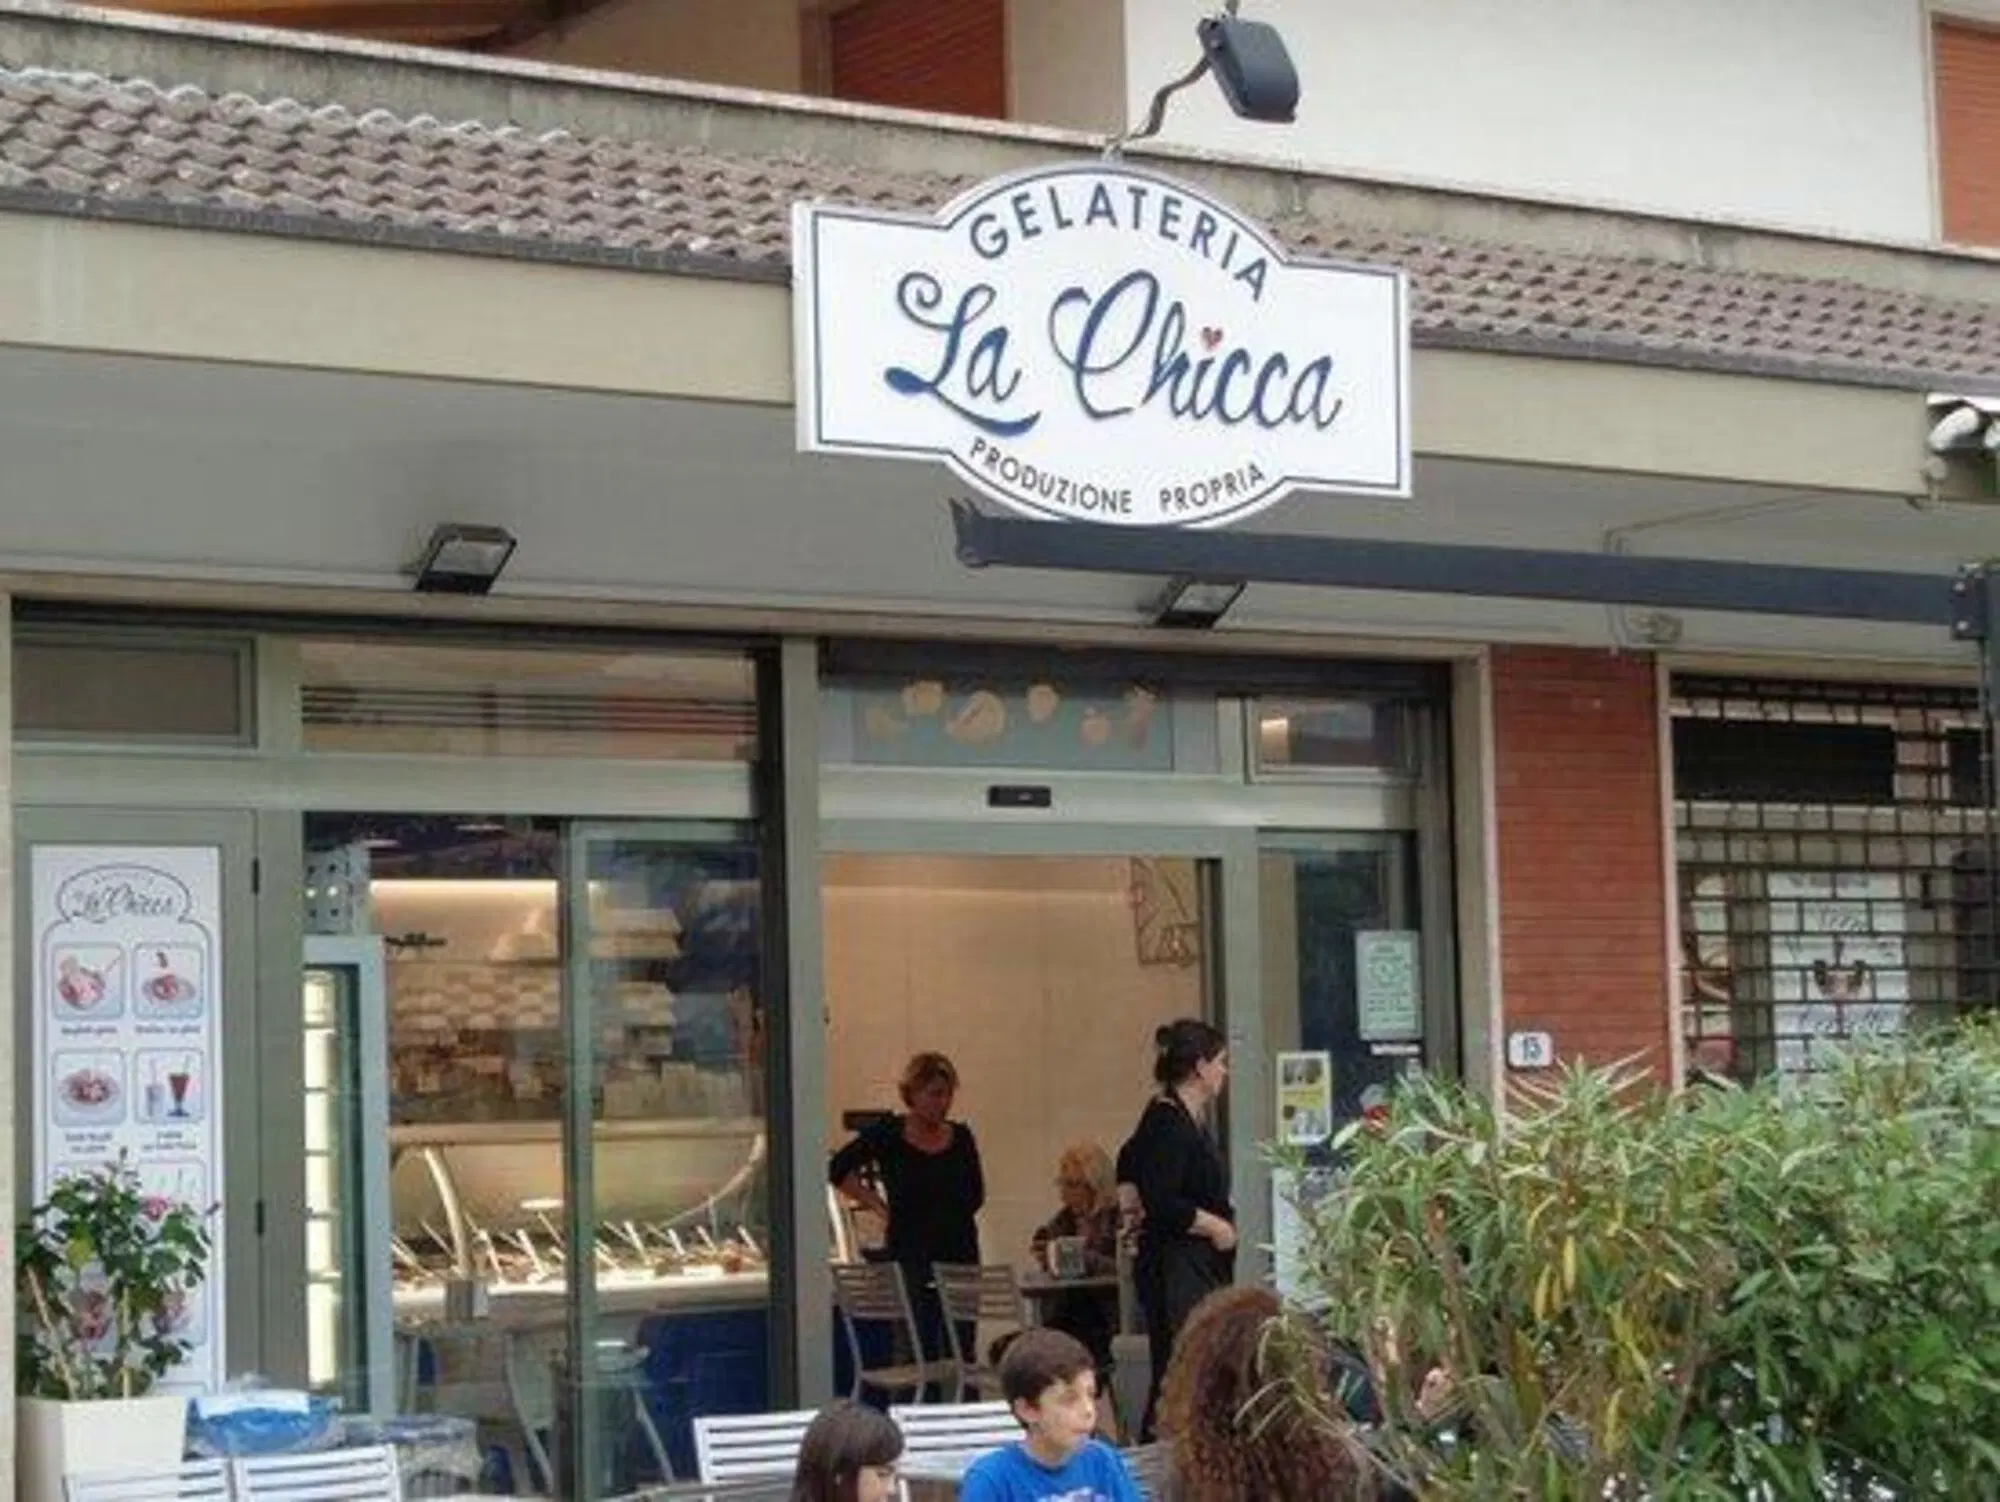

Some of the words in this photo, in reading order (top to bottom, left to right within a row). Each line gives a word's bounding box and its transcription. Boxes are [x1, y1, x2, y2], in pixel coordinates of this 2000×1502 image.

[969, 181, 1267, 301] GELATERIA
[884, 271, 1041, 437] La
[1048, 269, 1342, 429] Chicca
[969, 436, 1133, 514] PRODUZIONE
[1159, 462, 1266, 514] PROPRIA
